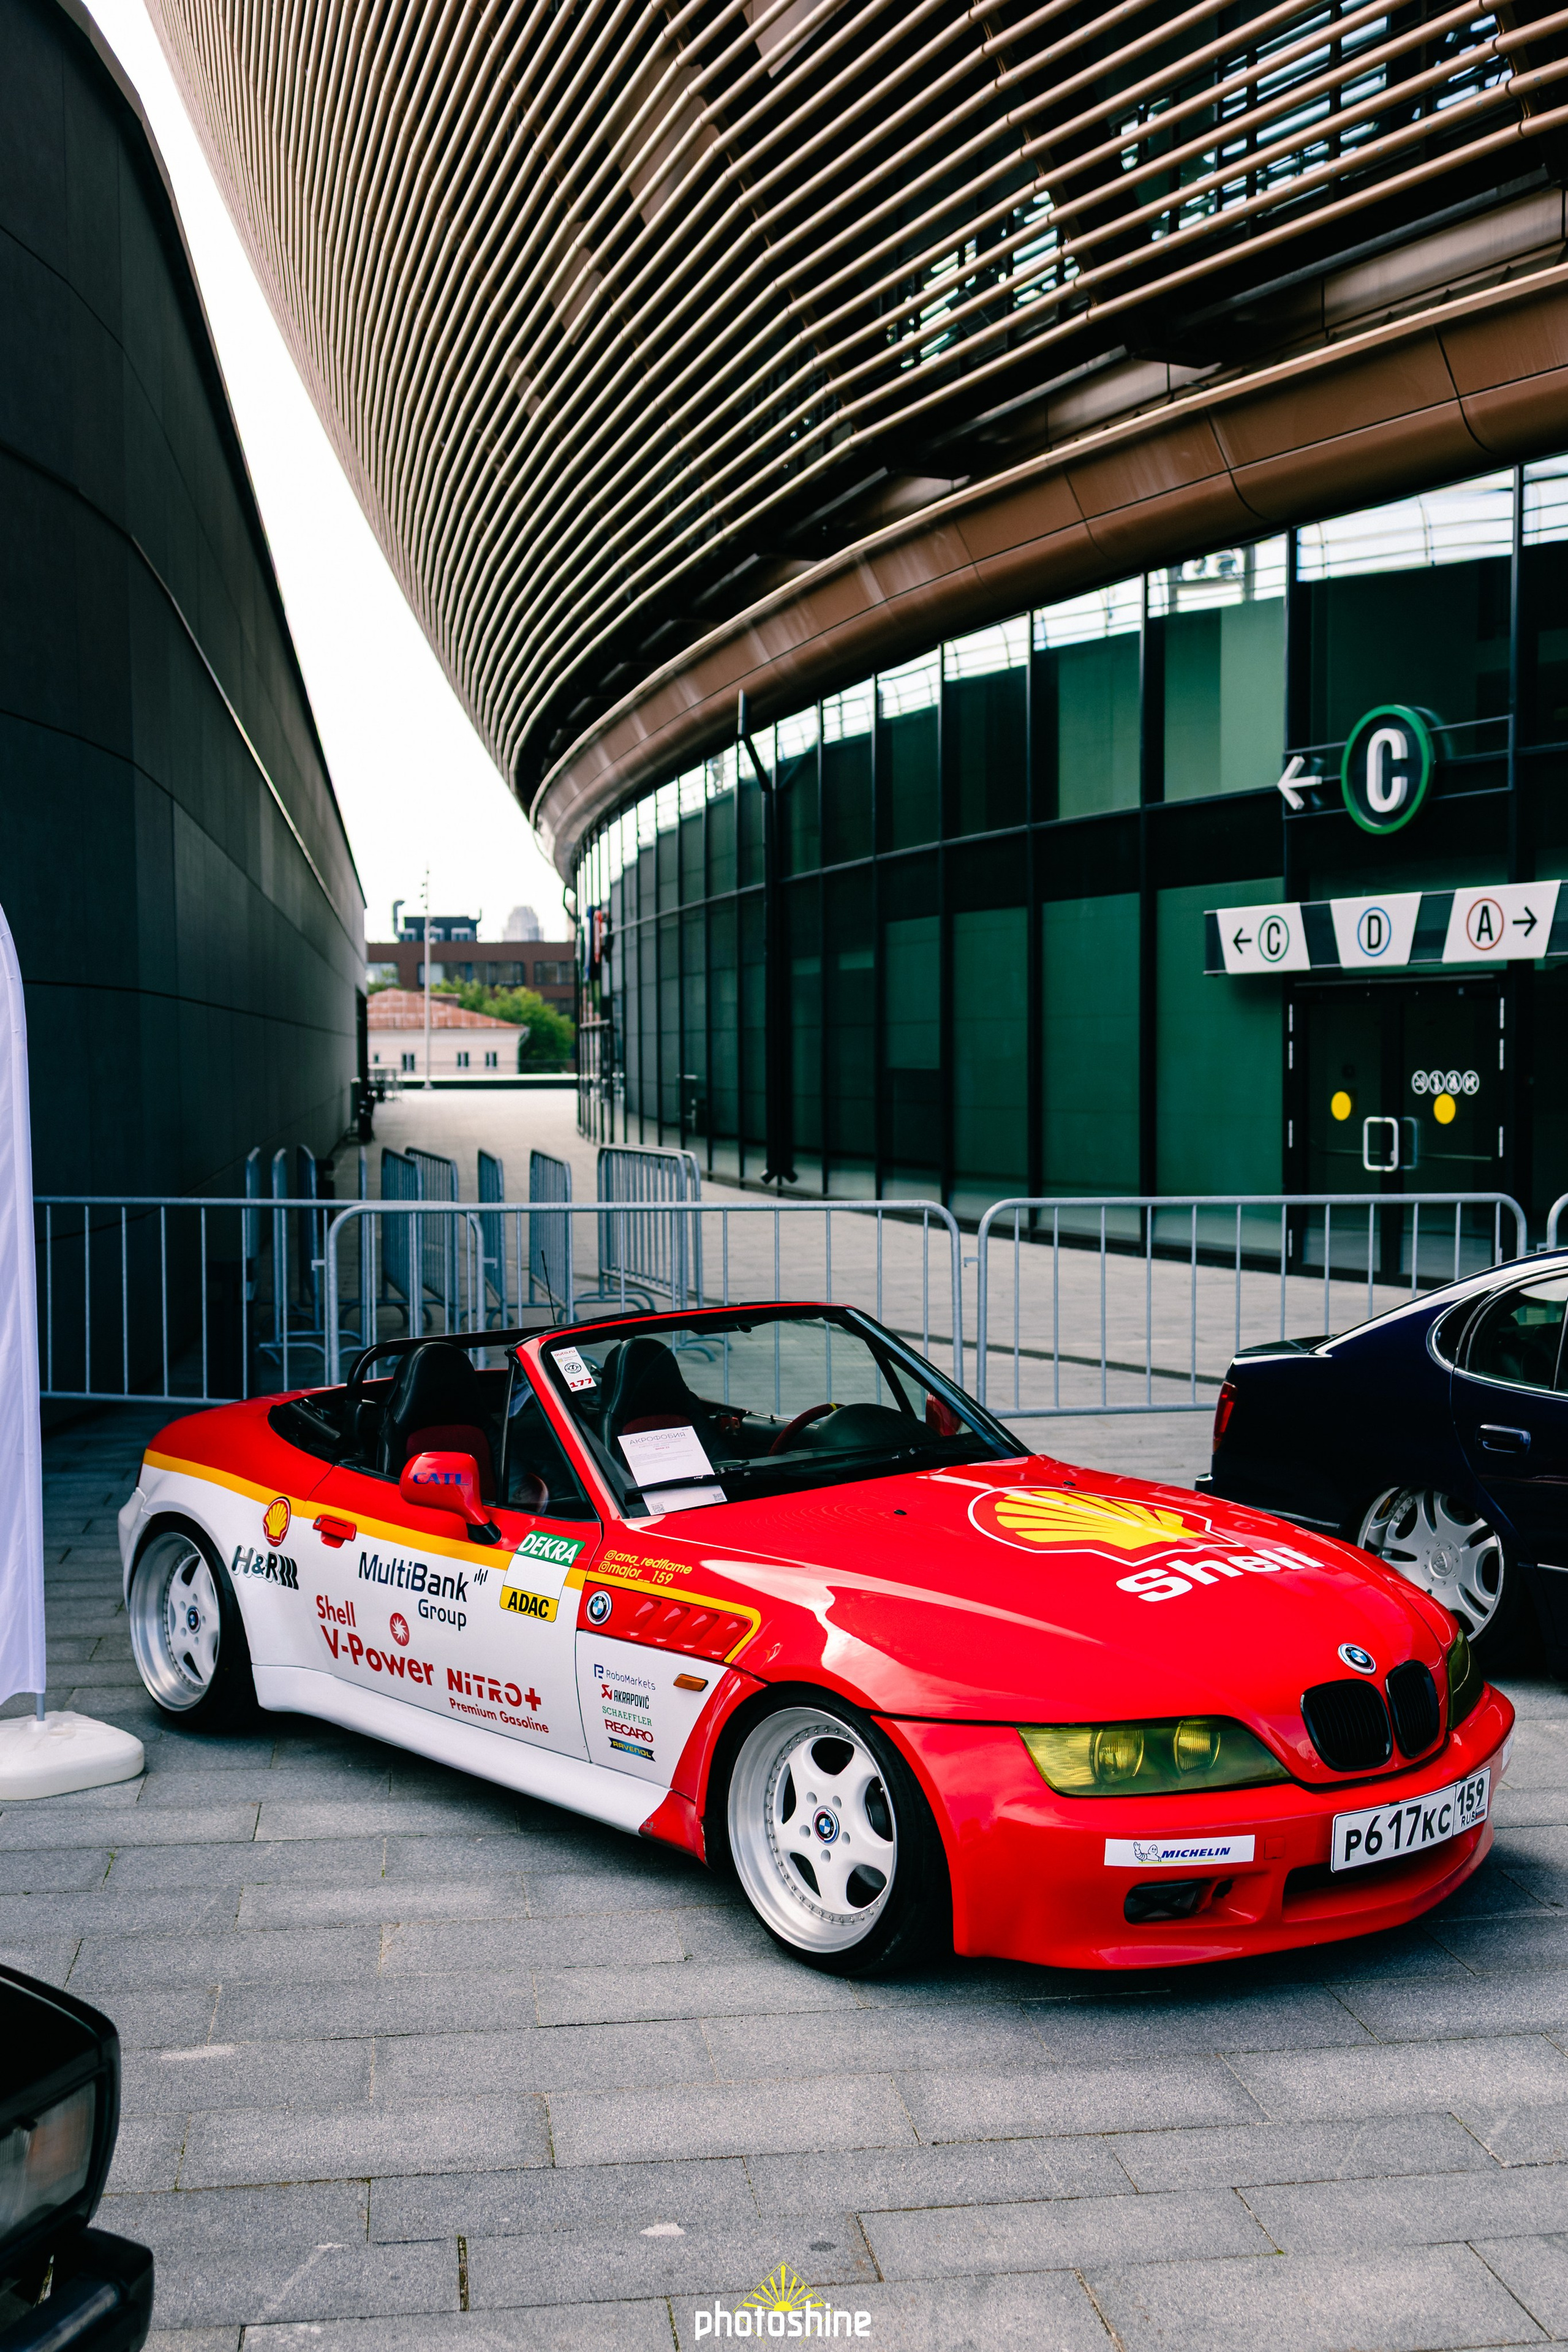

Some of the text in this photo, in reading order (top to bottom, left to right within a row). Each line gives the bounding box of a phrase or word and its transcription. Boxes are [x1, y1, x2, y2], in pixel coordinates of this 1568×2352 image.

[1366, 728, 1408, 813] C
[1267, 922, 1281, 956] C
[1367, 914, 1382, 949] D
[1476, 905, 1493, 942] A
[569, 1378, 592, 1389] 177
[630, 1432, 686, 1445] АКРОФОБИЯ
[413, 1472, 469, 1486] CATL
[231, 1545, 282, 1585] H&R
[518, 1532, 579, 1565] DEKRA
[358, 1551, 470, 1603] MultiBank
[1115, 1546, 1325, 1602] Shell
[316, 1594, 356, 1628] Shell
[418, 1599, 467, 1632] Group
[507, 1591, 550, 1619] ADAC
[320, 1624, 435, 1686] V-Power
[606, 1669, 656, 1691] RoboMarkets
[448, 1697, 550, 1733] Premium Gasoline
[602, 1705, 652, 1727] SCHAEFFLER
[604, 1719, 654, 1743] RECARO
[612, 1741, 652, 1758] RAVENOL
[1457, 1777, 1485, 1816] 159
[1460, 1811, 1477, 1828] RUS
[1161, 1847, 1231, 1858] MICHELIN
